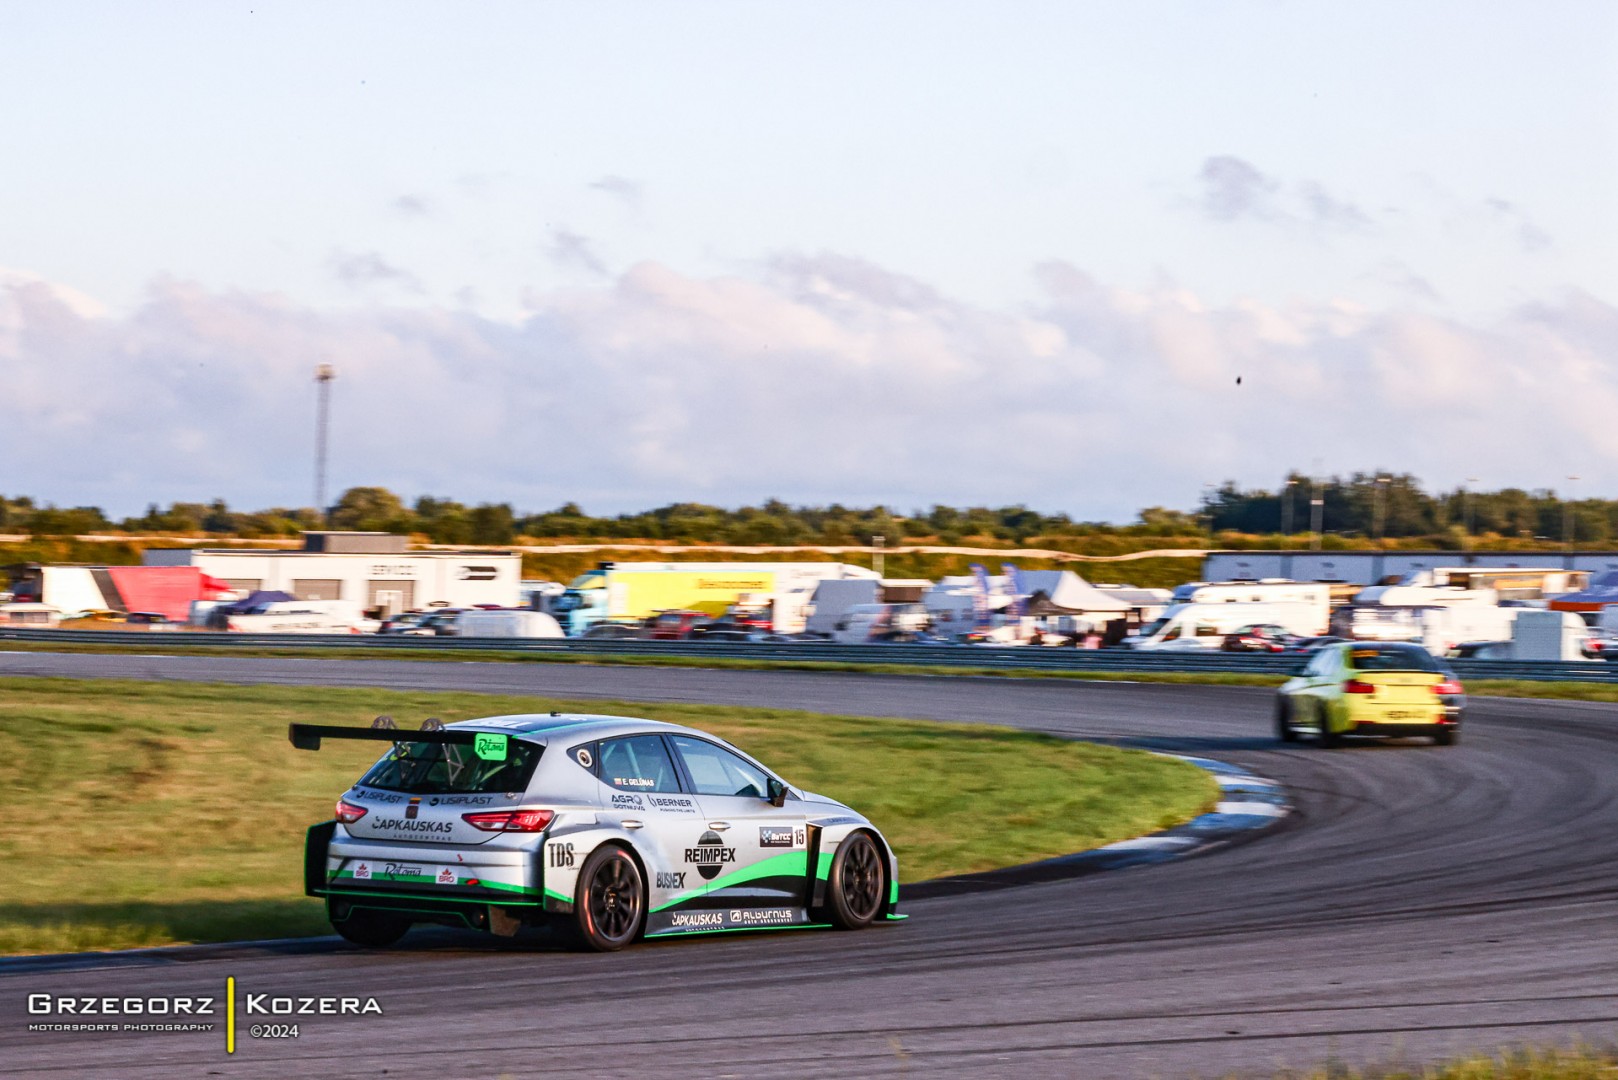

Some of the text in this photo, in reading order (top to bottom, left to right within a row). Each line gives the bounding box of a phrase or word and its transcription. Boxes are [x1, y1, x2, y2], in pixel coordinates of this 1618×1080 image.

[656, 798, 693, 808] BERNER
[794, 828, 805, 845] 15
[548, 842, 574, 868] TDS
[684, 847, 736, 863] REIMPEX
